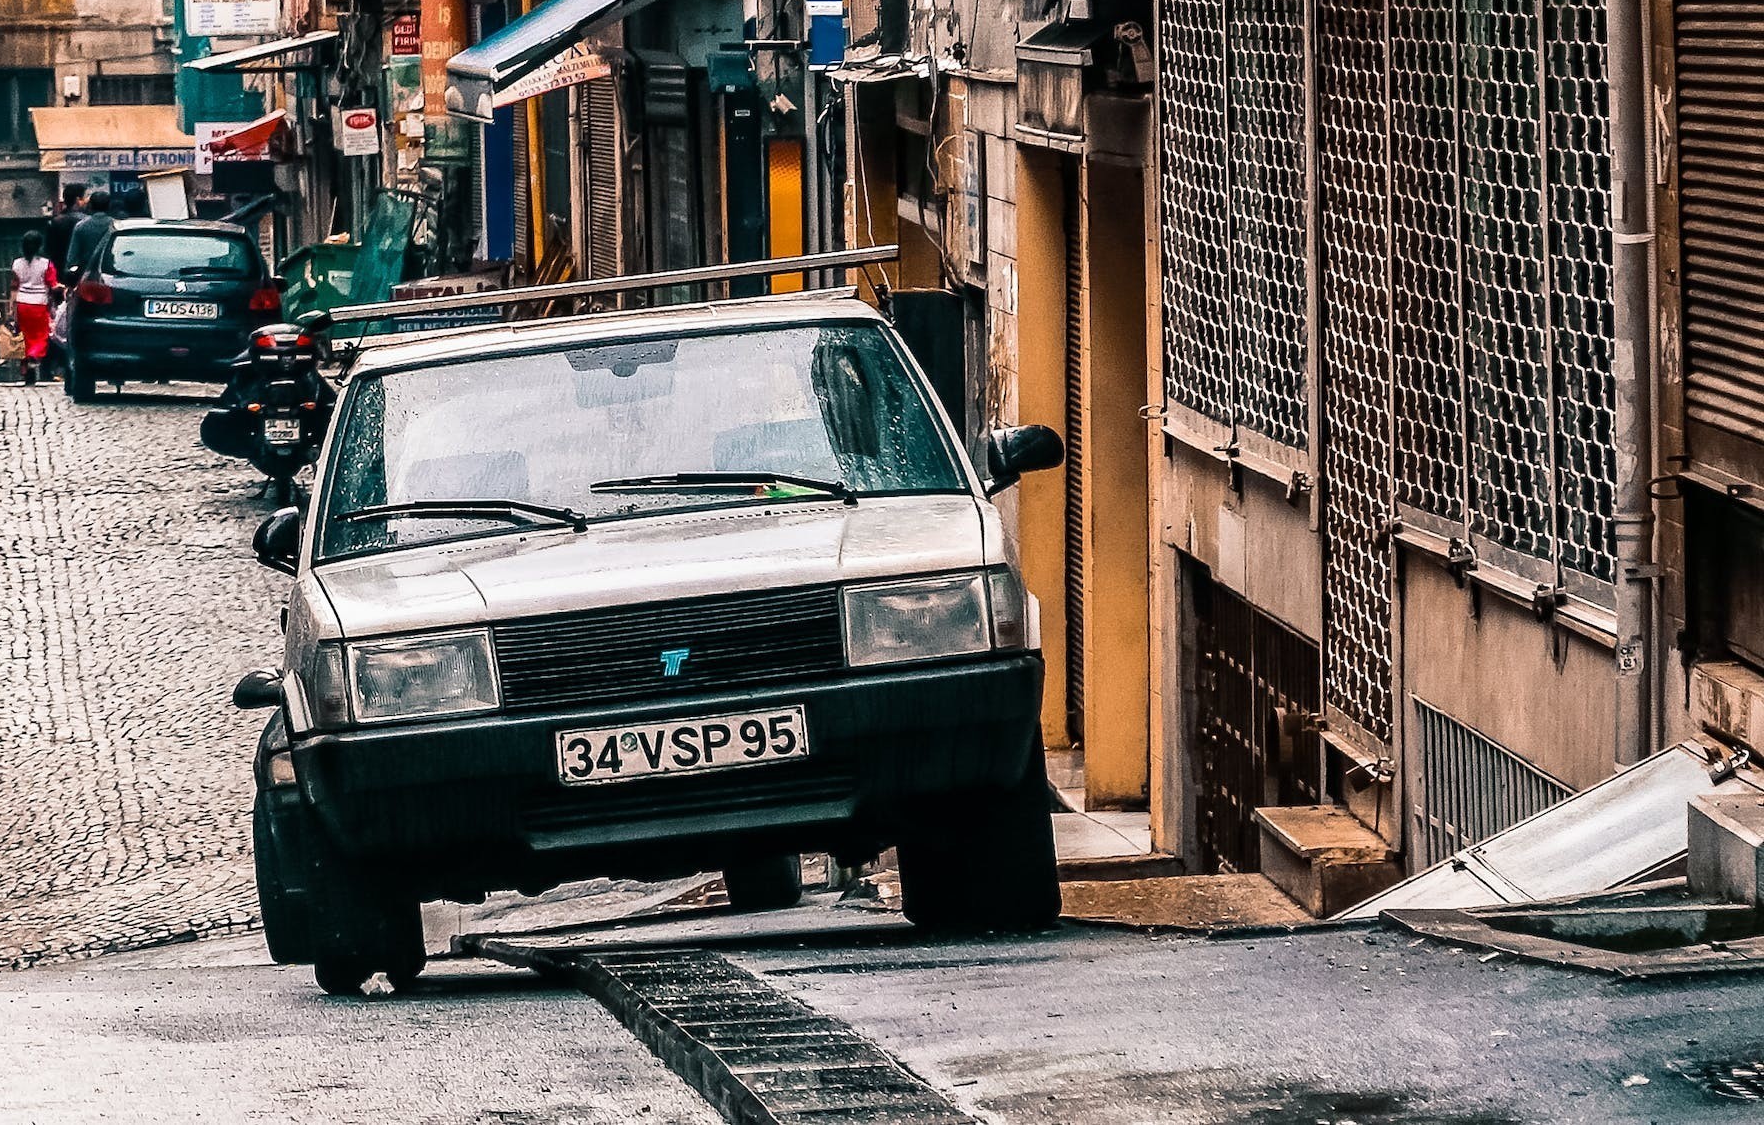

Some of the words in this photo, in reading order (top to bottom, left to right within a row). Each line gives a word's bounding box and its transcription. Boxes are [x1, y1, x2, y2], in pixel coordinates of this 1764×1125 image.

[154, 301, 169, 314] 34
[170, 302, 187, 315] DS
[566, 734, 624, 778] 34
[636, 722, 732, 770] VSP
[738, 714, 798, 760] 95
